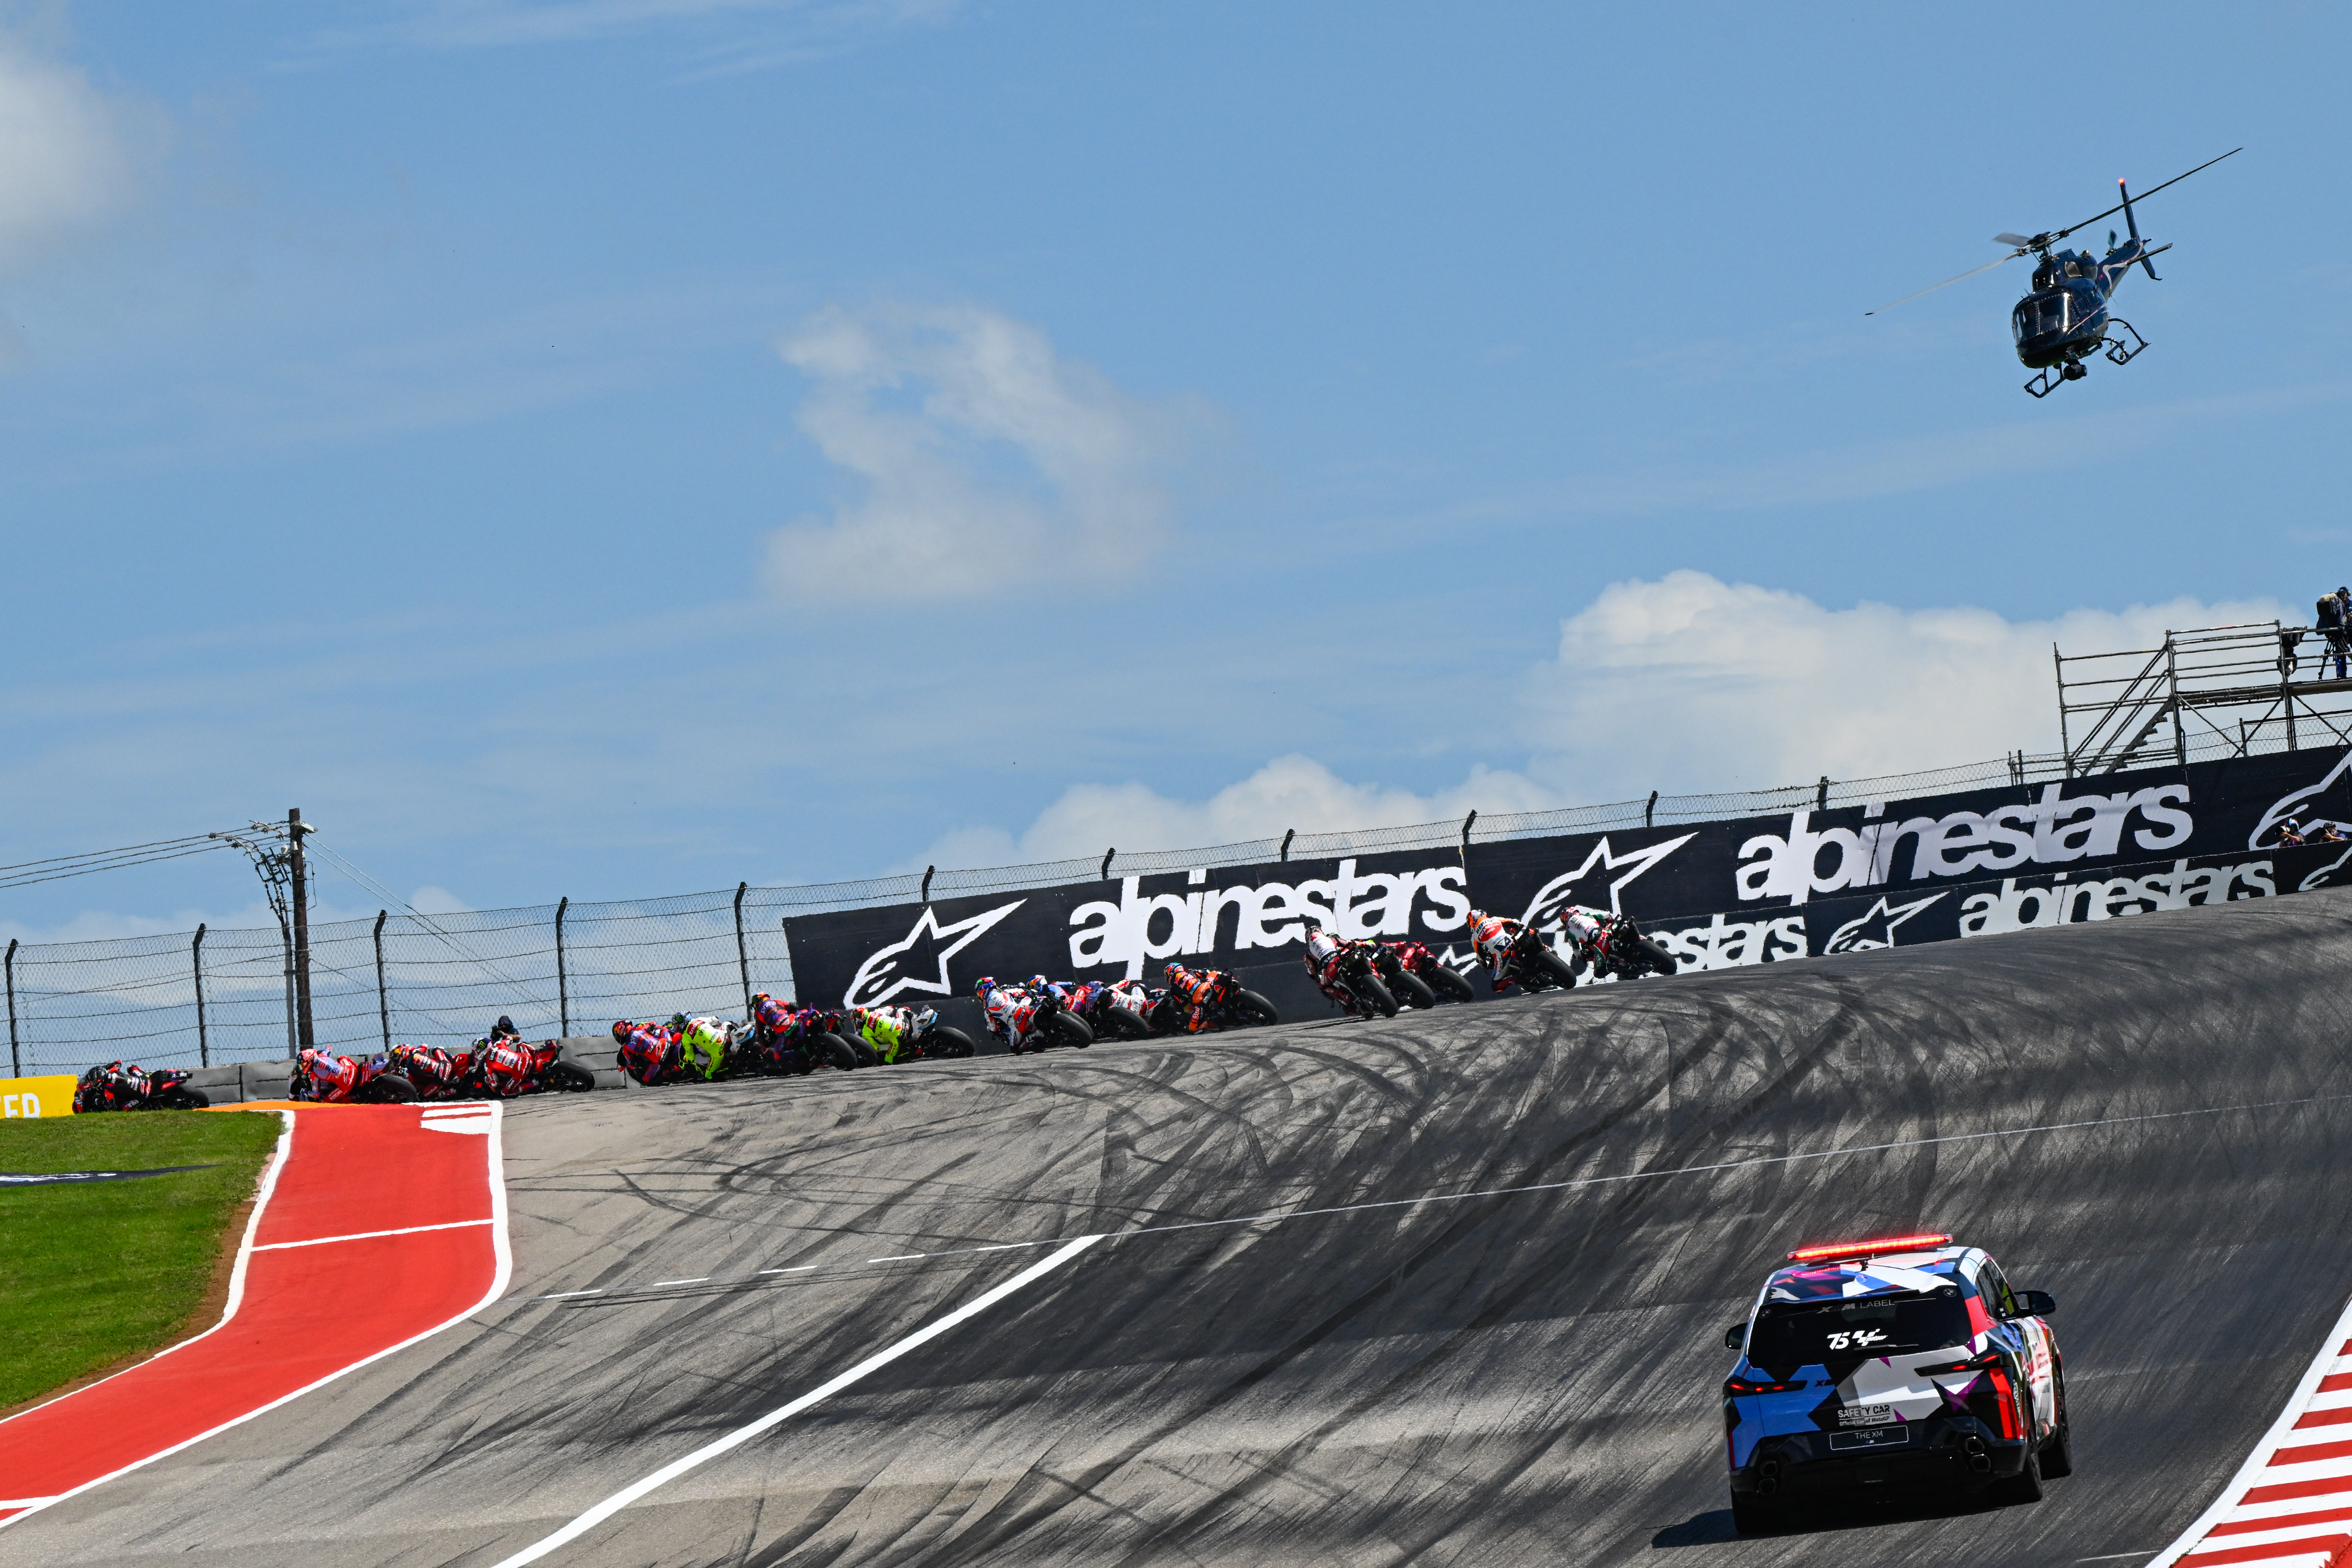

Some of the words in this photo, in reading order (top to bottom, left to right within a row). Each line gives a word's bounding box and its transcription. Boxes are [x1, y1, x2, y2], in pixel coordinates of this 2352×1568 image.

[1736, 783, 2193, 906] alpinestars
[1069, 859, 1471, 980] alpinestars
[1960, 859, 2276, 938] alpinestars
[1860, 1300, 1895, 1308] LABEL
[1827, 1332, 1851, 1350] 75
[1838, 1407, 1870, 1418] SAFETY
[1873, 1405, 1890, 1414] CAR
